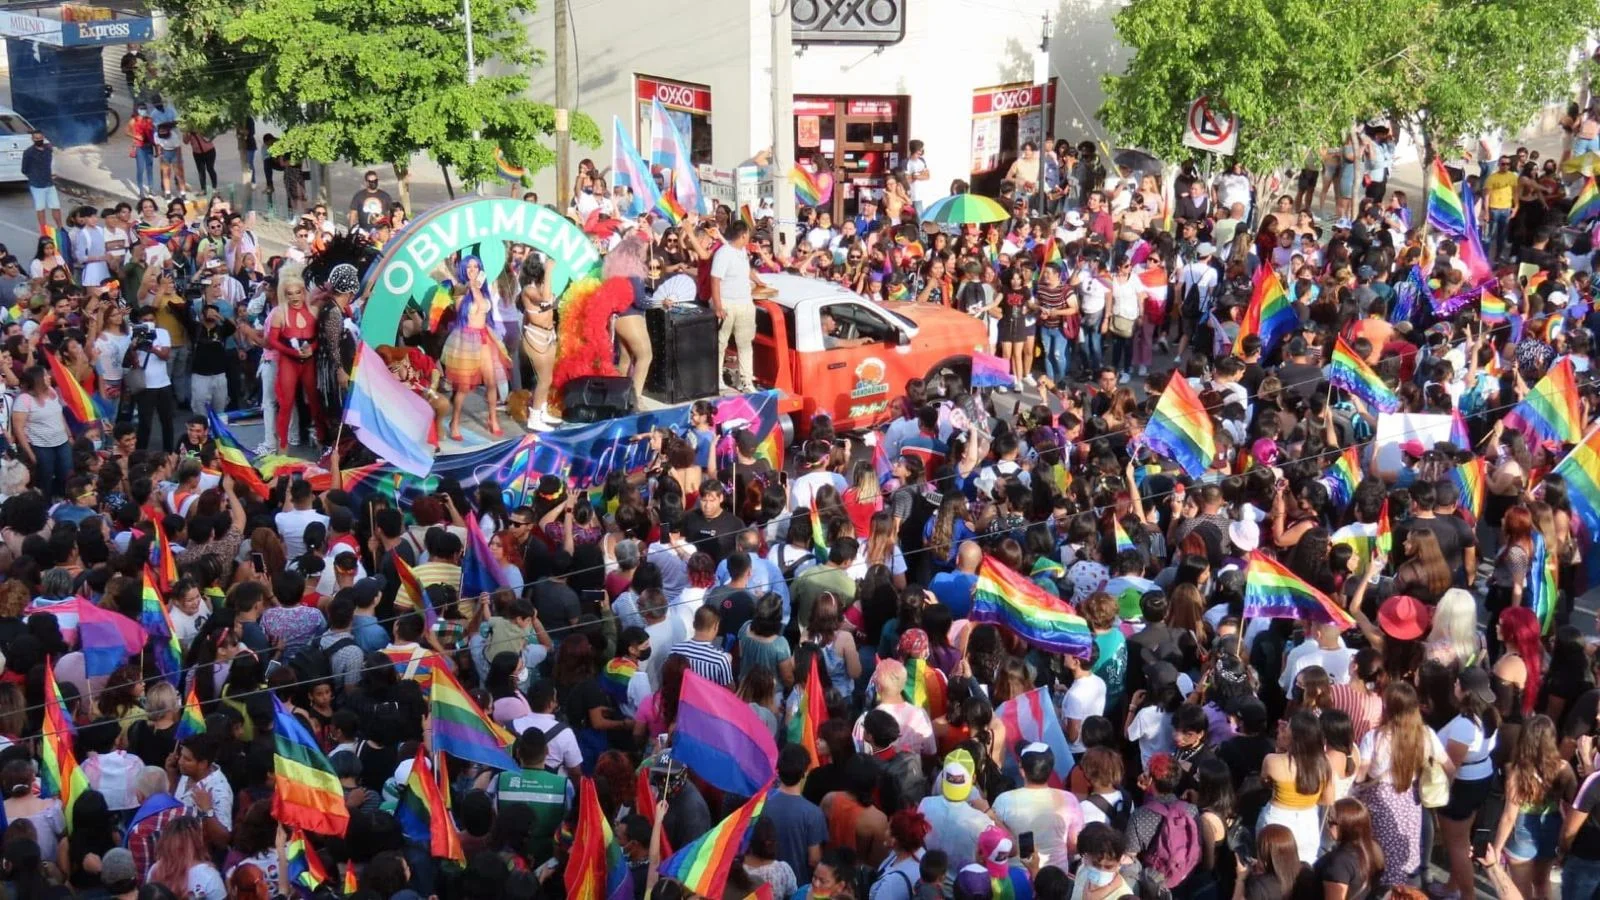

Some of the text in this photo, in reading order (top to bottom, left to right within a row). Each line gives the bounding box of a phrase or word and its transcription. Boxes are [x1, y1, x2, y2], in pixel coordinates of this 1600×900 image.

[791, 0, 897, 31] OXXO
[78, 22, 130, 40] Express
[658, 85, 693, 106] OXXO
[994, 90, 1030, 110] OXXO
[383, 202, 599, 295] OBVI.MENT
